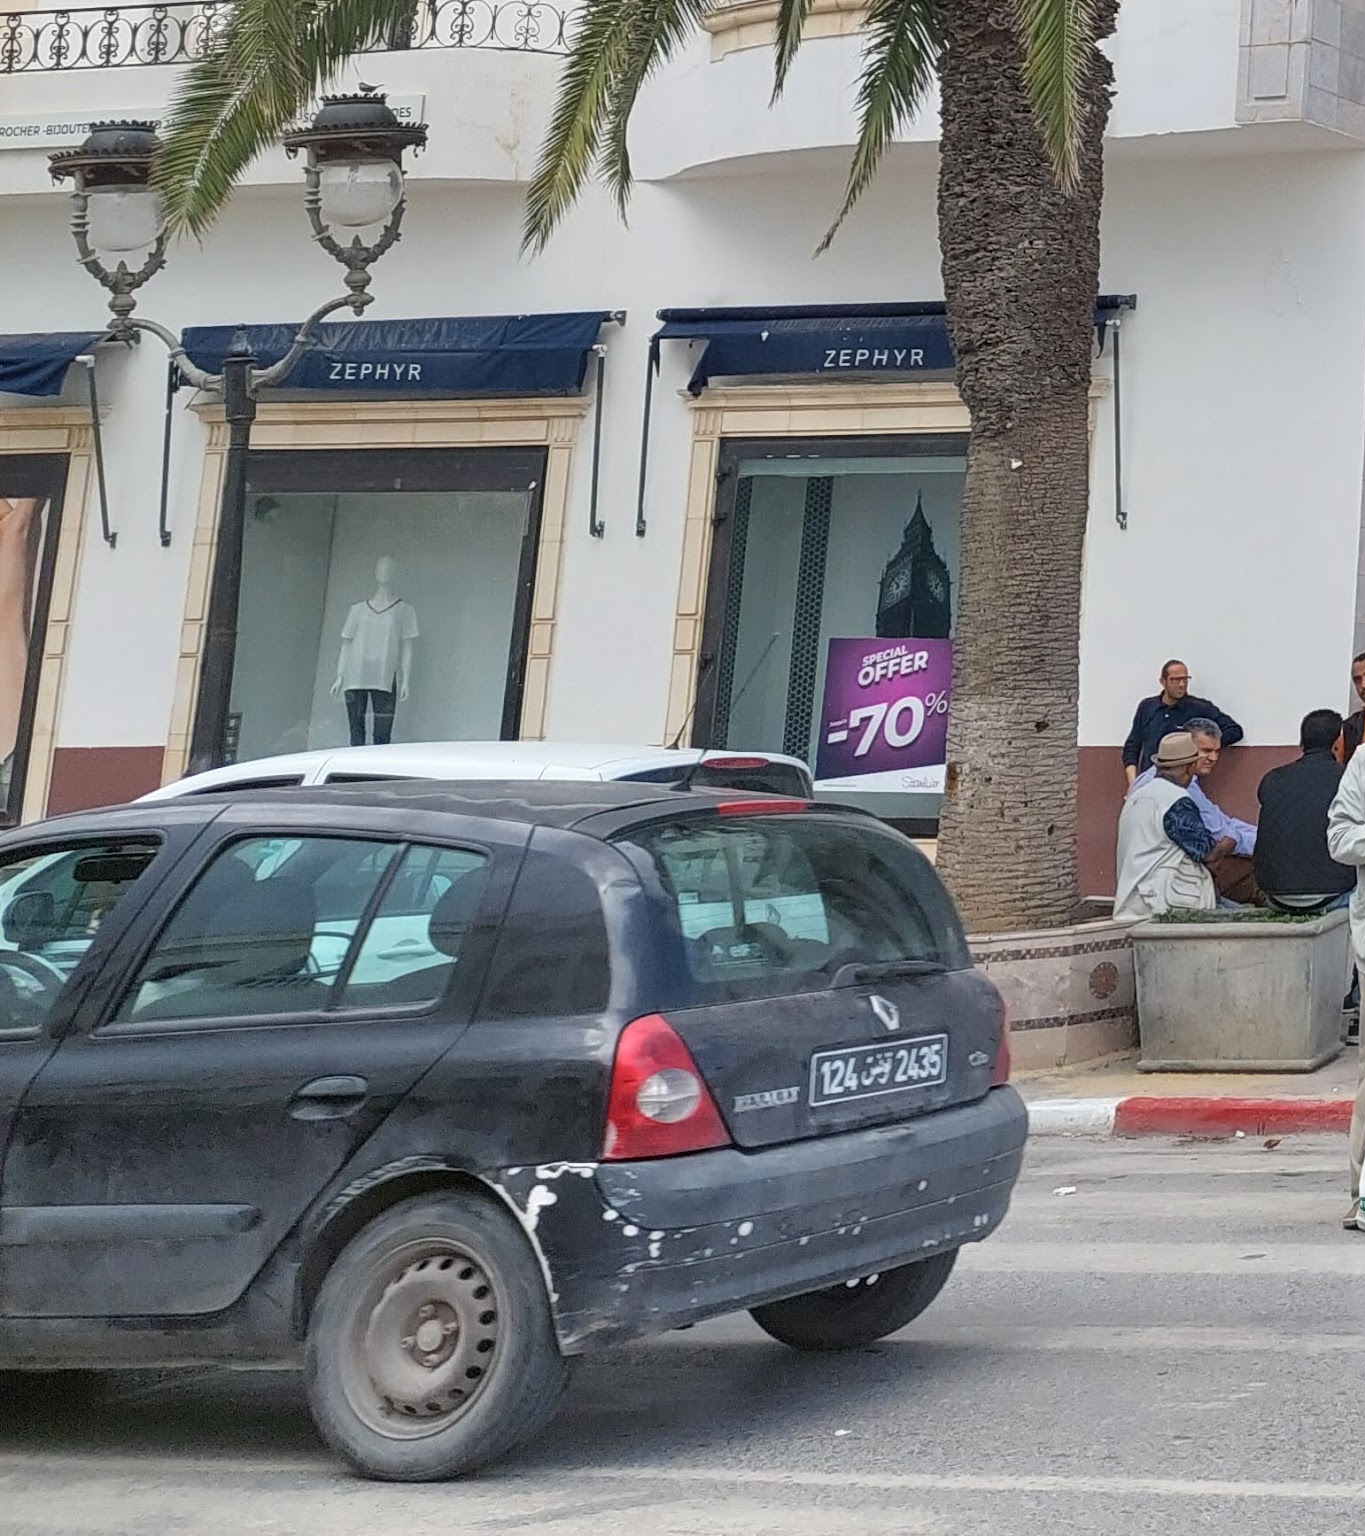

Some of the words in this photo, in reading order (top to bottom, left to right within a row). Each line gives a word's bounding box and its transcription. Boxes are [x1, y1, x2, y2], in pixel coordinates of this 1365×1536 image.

[823, 349, 924, 367] ZEPHYR
[329, 363, 422, 380] ZEPHYR
[862, 645, 908, 667] SPECIAL
[858, 651, 929, 686] OFFER
[820, 1057, 859, 1095] 124
[894, 1044, 942, 1082] 2435
